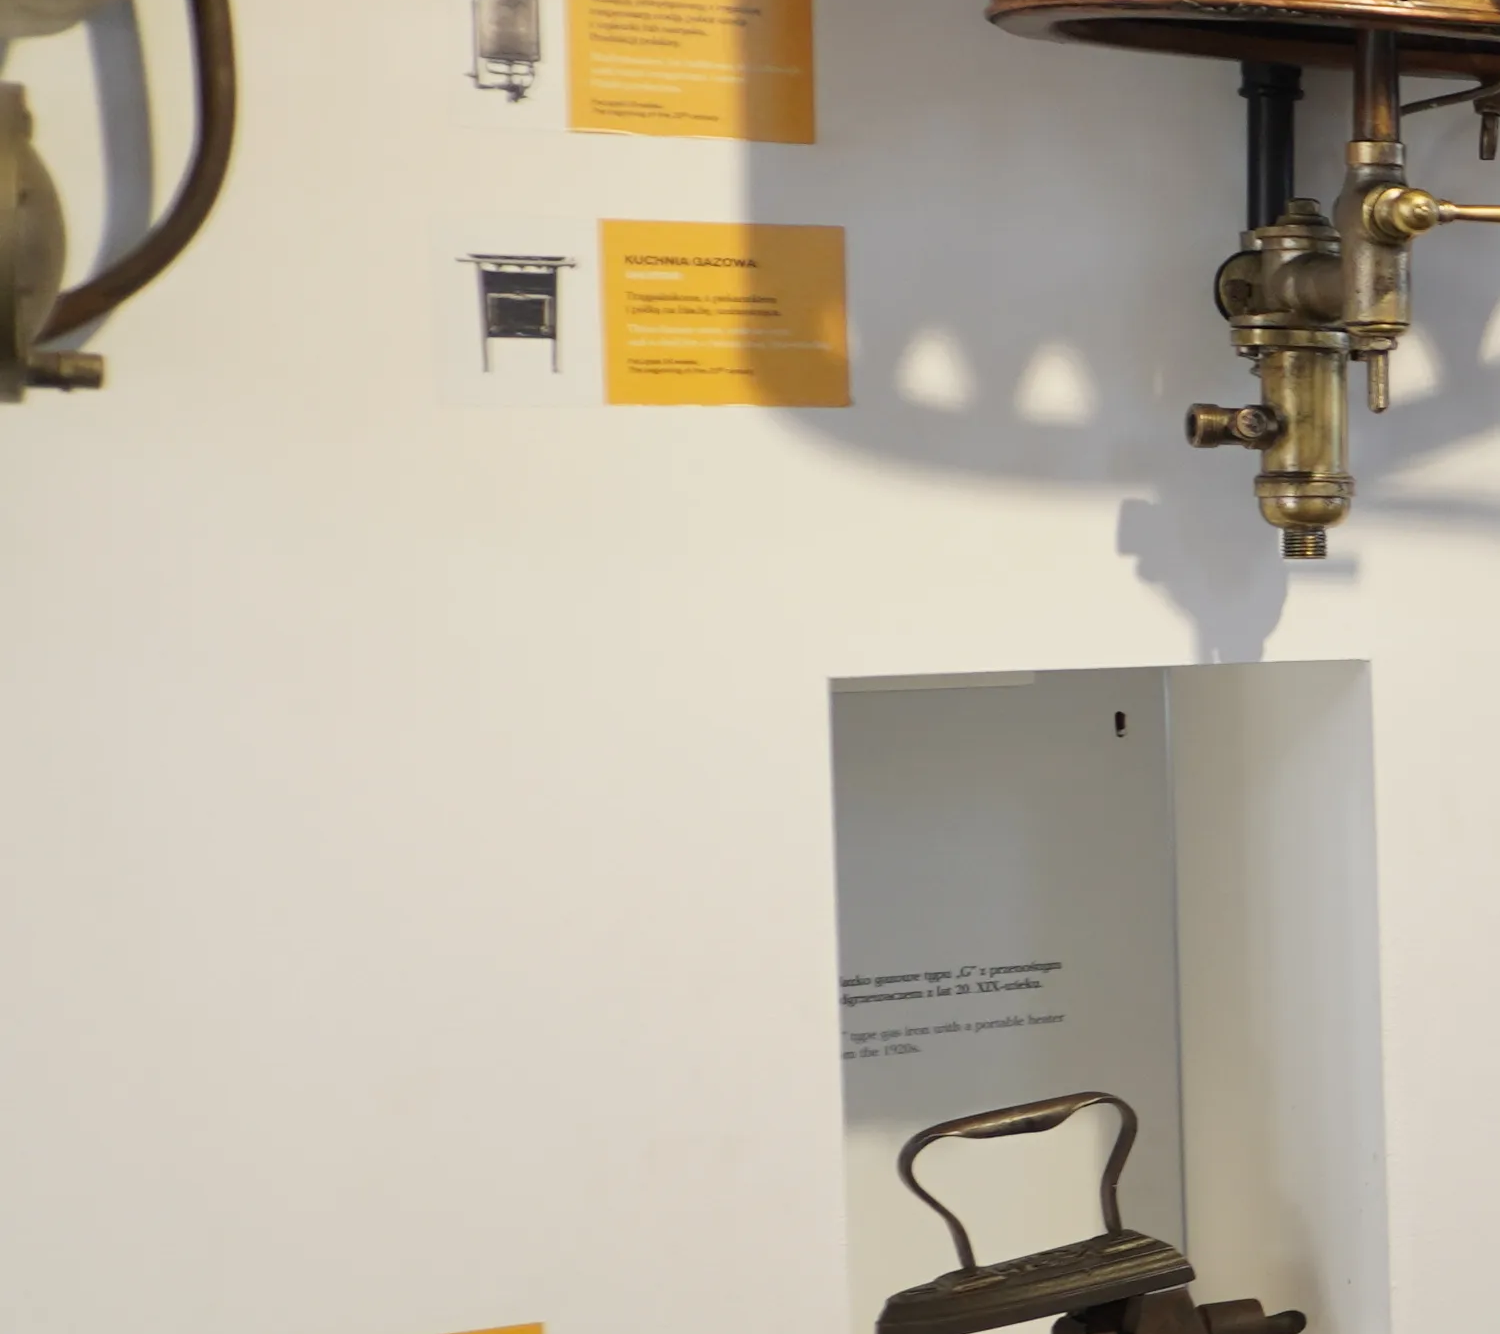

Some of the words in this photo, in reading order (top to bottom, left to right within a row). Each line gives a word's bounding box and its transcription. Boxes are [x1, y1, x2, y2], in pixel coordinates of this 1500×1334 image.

[624, 255, 689, 267] KUCHNIA
[692, 257, 758, 268] GAZOWA
[874, 973, 921, 988] gazowe
[975, 1015, 1025, 1033] portable
[1027, 1014, 1067, 1025] heater
